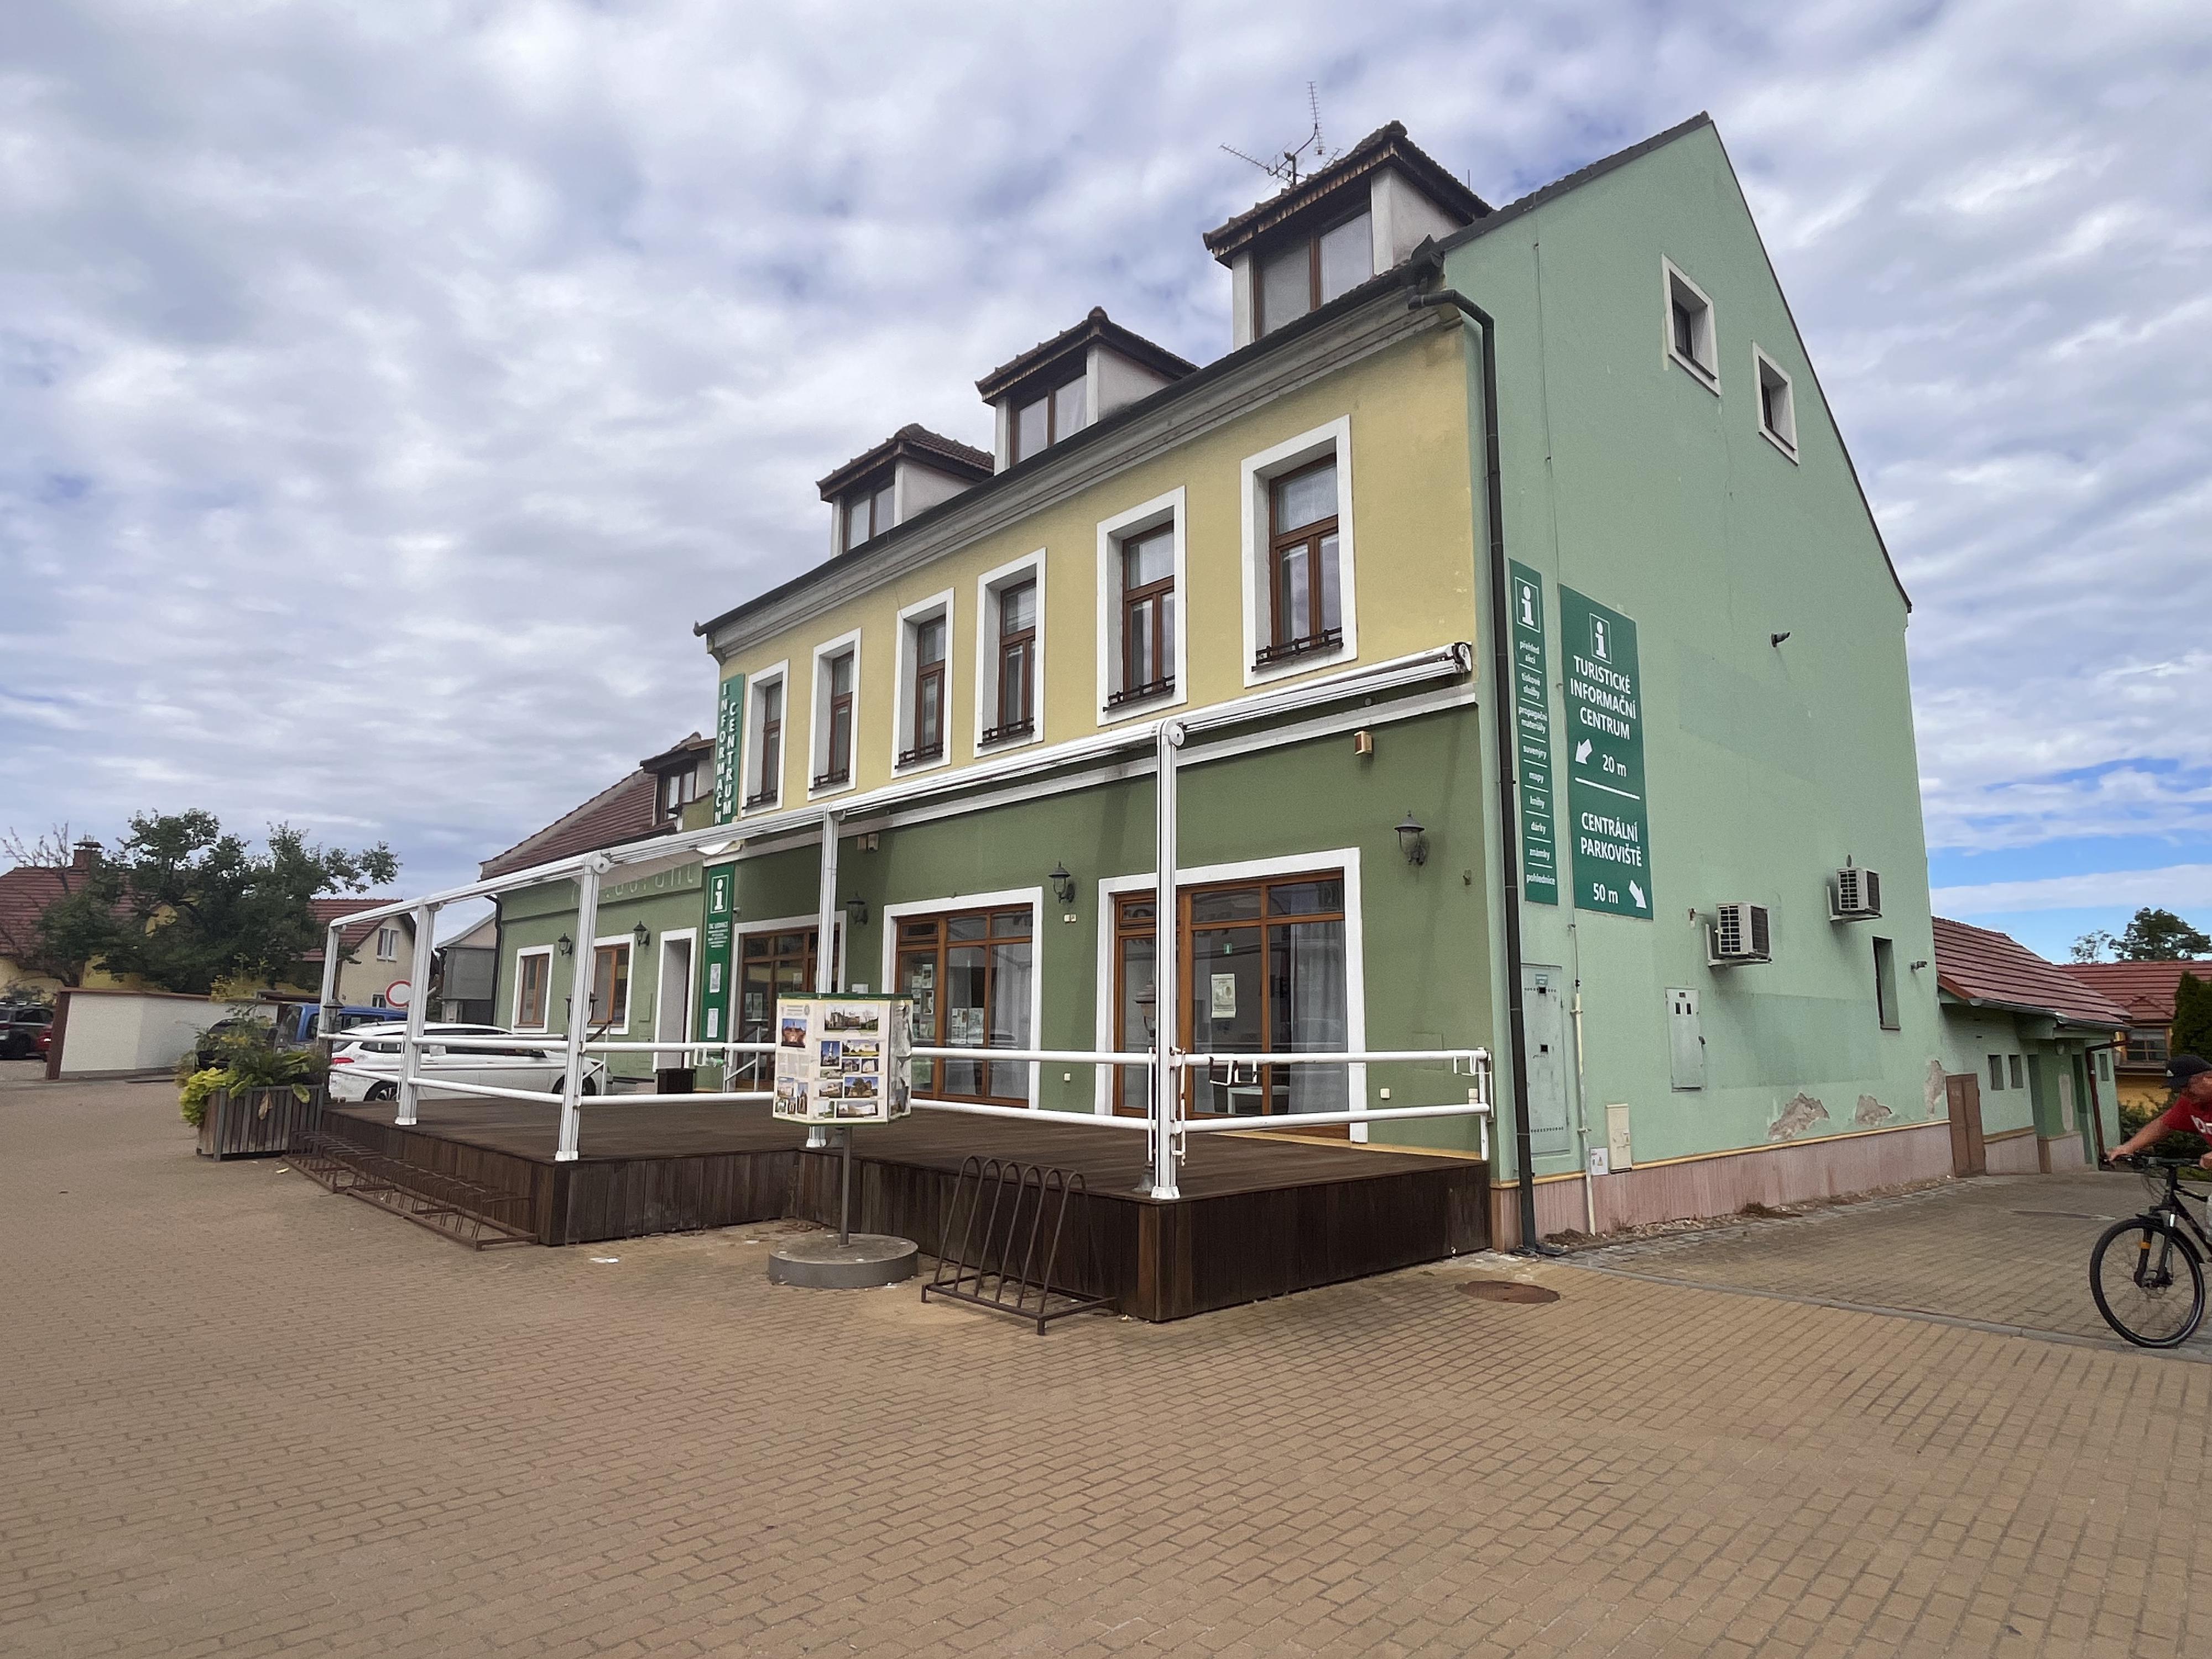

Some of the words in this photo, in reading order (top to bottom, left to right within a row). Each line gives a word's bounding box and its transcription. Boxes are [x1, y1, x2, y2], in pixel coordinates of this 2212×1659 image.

[1573, 654, 1631, 695] TURISTICKÉ
[1569, 677, 1637, 720] INFORMAČNÍ
[1579, 706, 1631, 740] CENTRUM
[714, 682, 728, 825] INFORMAČN
[723, 702, 736, 815] CENTRUM
[1523, 745, 1547, 760] suvenýry
[1602, 754, 1615, 774] 20
[1616, 761, 1627, 777] m
[1528, 772, 1544, 784] mapy
[1530, 795, 1545, 810] knihy
[1531, 821, 1547, 835] dárky
[1581, 811, 1639, 843] CENTRÁLNÍ
[1580, 836, 1643, 867] PARKOVIŠTĚ
[1593, 882, 1606, 902] 50
[1608, 888, 1619, 904] m
